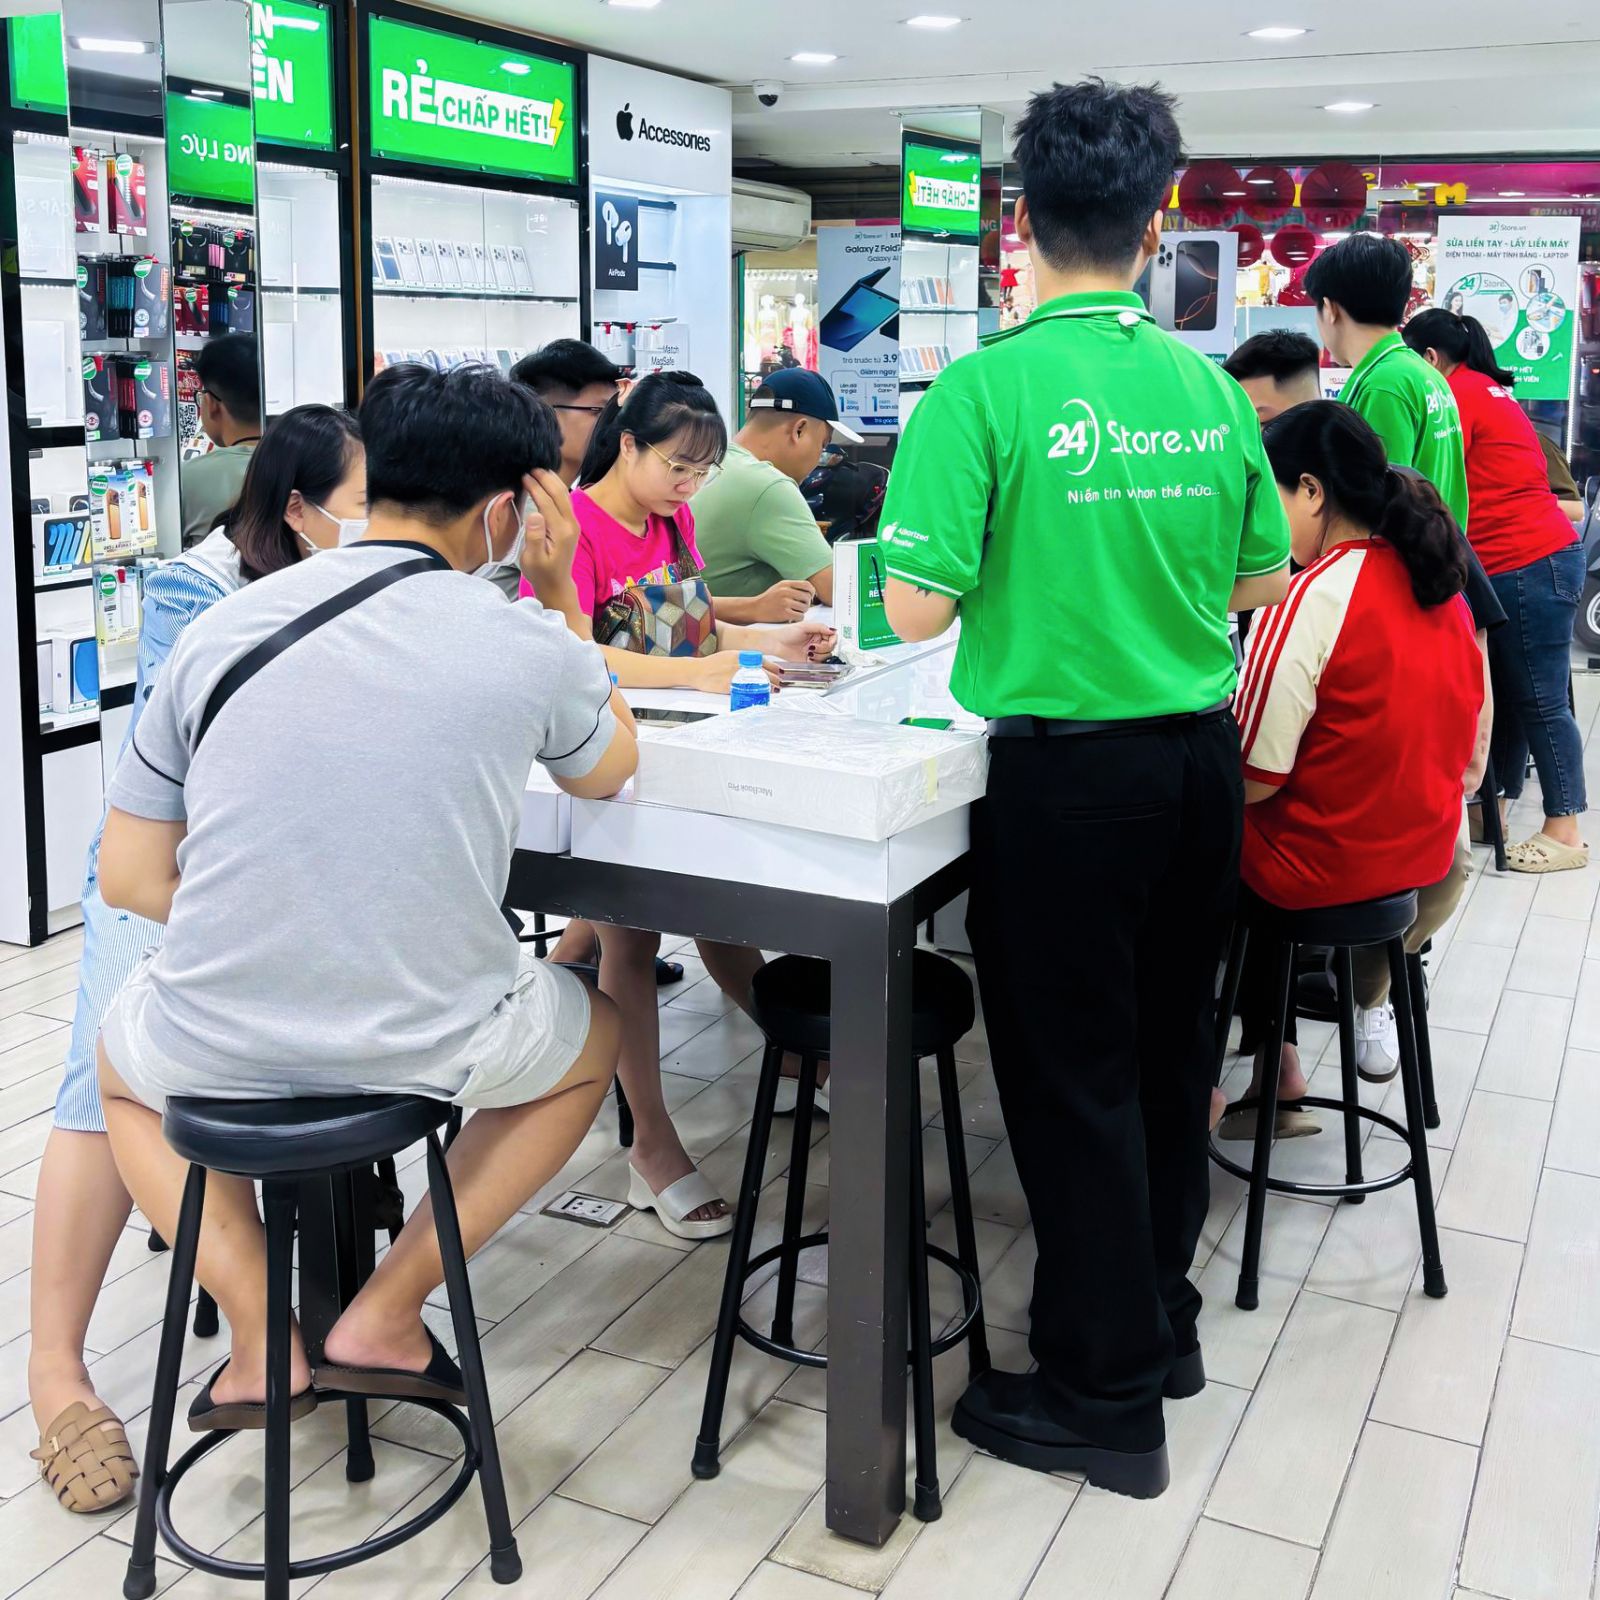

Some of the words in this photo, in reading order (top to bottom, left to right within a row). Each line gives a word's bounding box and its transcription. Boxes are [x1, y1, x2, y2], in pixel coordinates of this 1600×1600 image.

[382, 58, 438, 125] RẺ
[442, 95, 499, 129] CHẤP
[505, 104, 549, 139] HẾT!
[638, 118, 711, 152] Accessories
[845, 244, 874, 254] Galaxy
[1487, 240, 1503, 248] TAY
[608, 268, 626, 277] AirPods
[1104, 486, 1121, 500] tin
